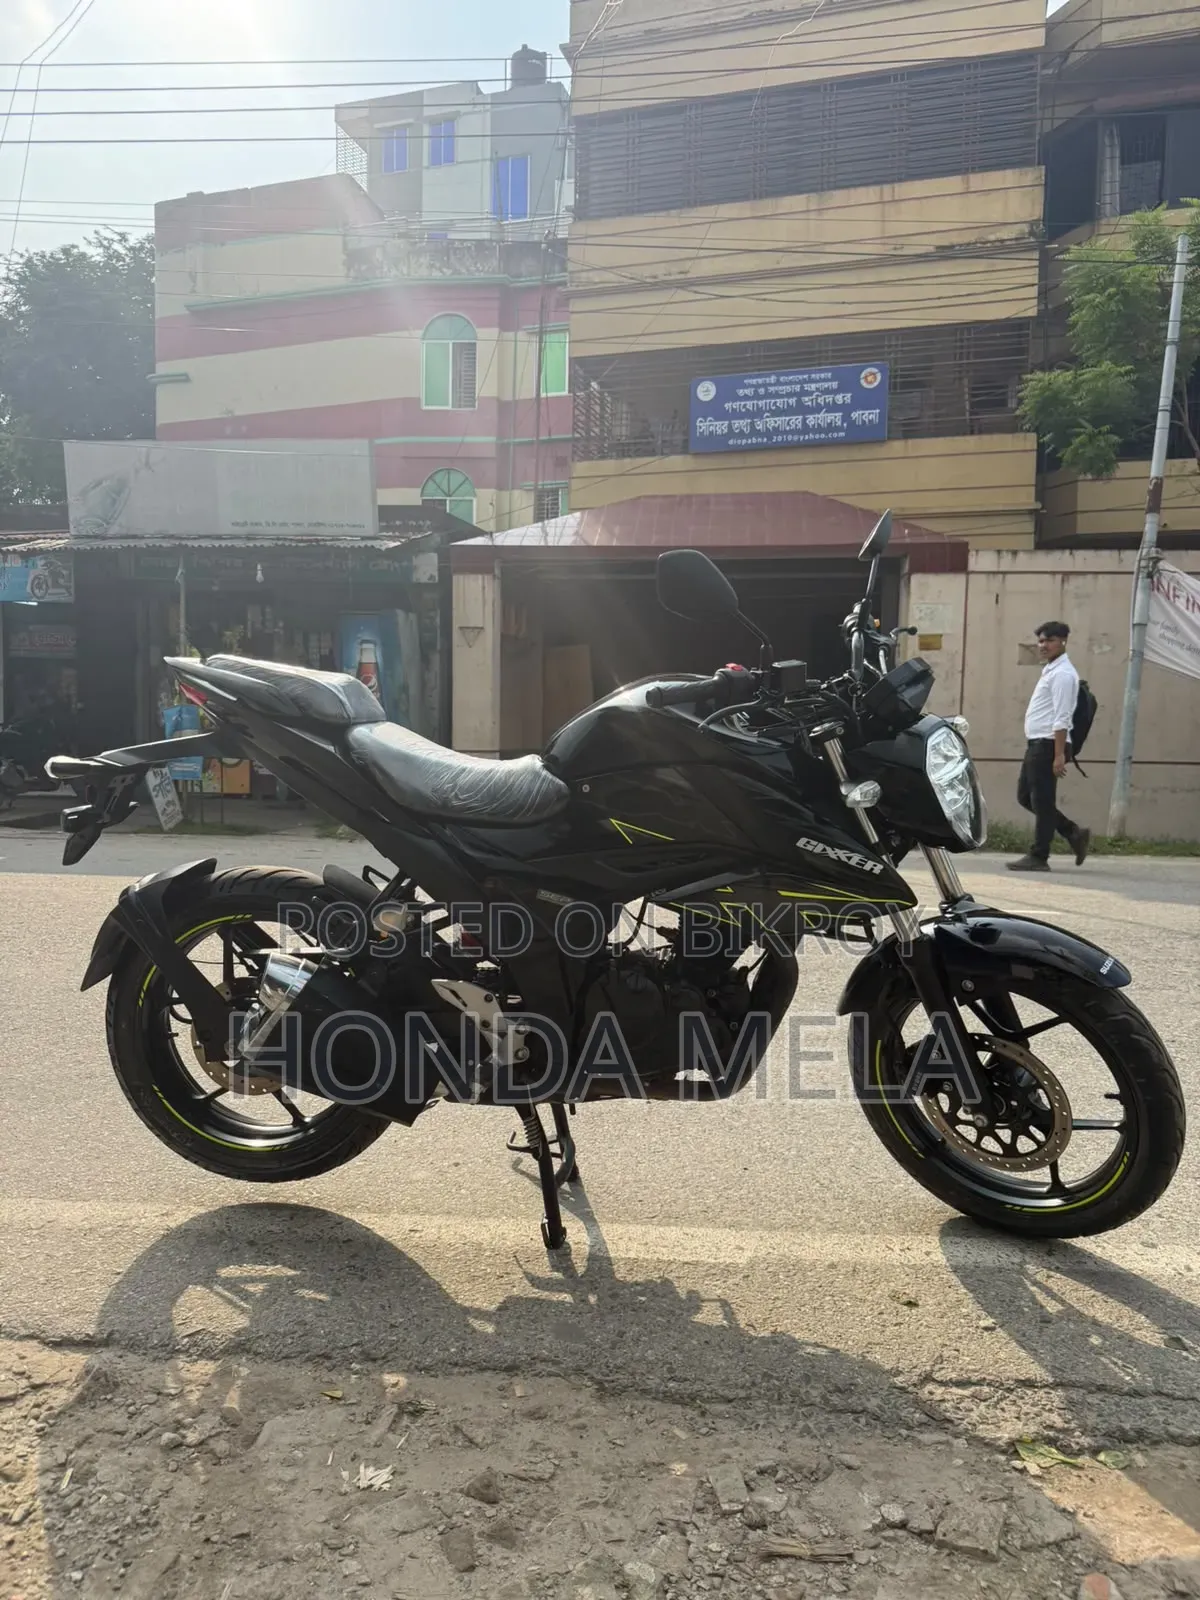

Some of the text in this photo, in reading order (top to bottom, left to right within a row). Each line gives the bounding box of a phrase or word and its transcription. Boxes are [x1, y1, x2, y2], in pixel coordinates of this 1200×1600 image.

[724, 392, 853, 413] গণযোগাযোগ অধিদপ্তর
[736, 387, 755, 396] তথ্য
[696, 417, 729, 437] সিনিয়র
[731, 420, 752, 434] তথ্য
[753, 412, 803, 432] অফিসারের
[850, 409, 880, 425] পাবনা
[795, 837, 884, 875] GIXXER
